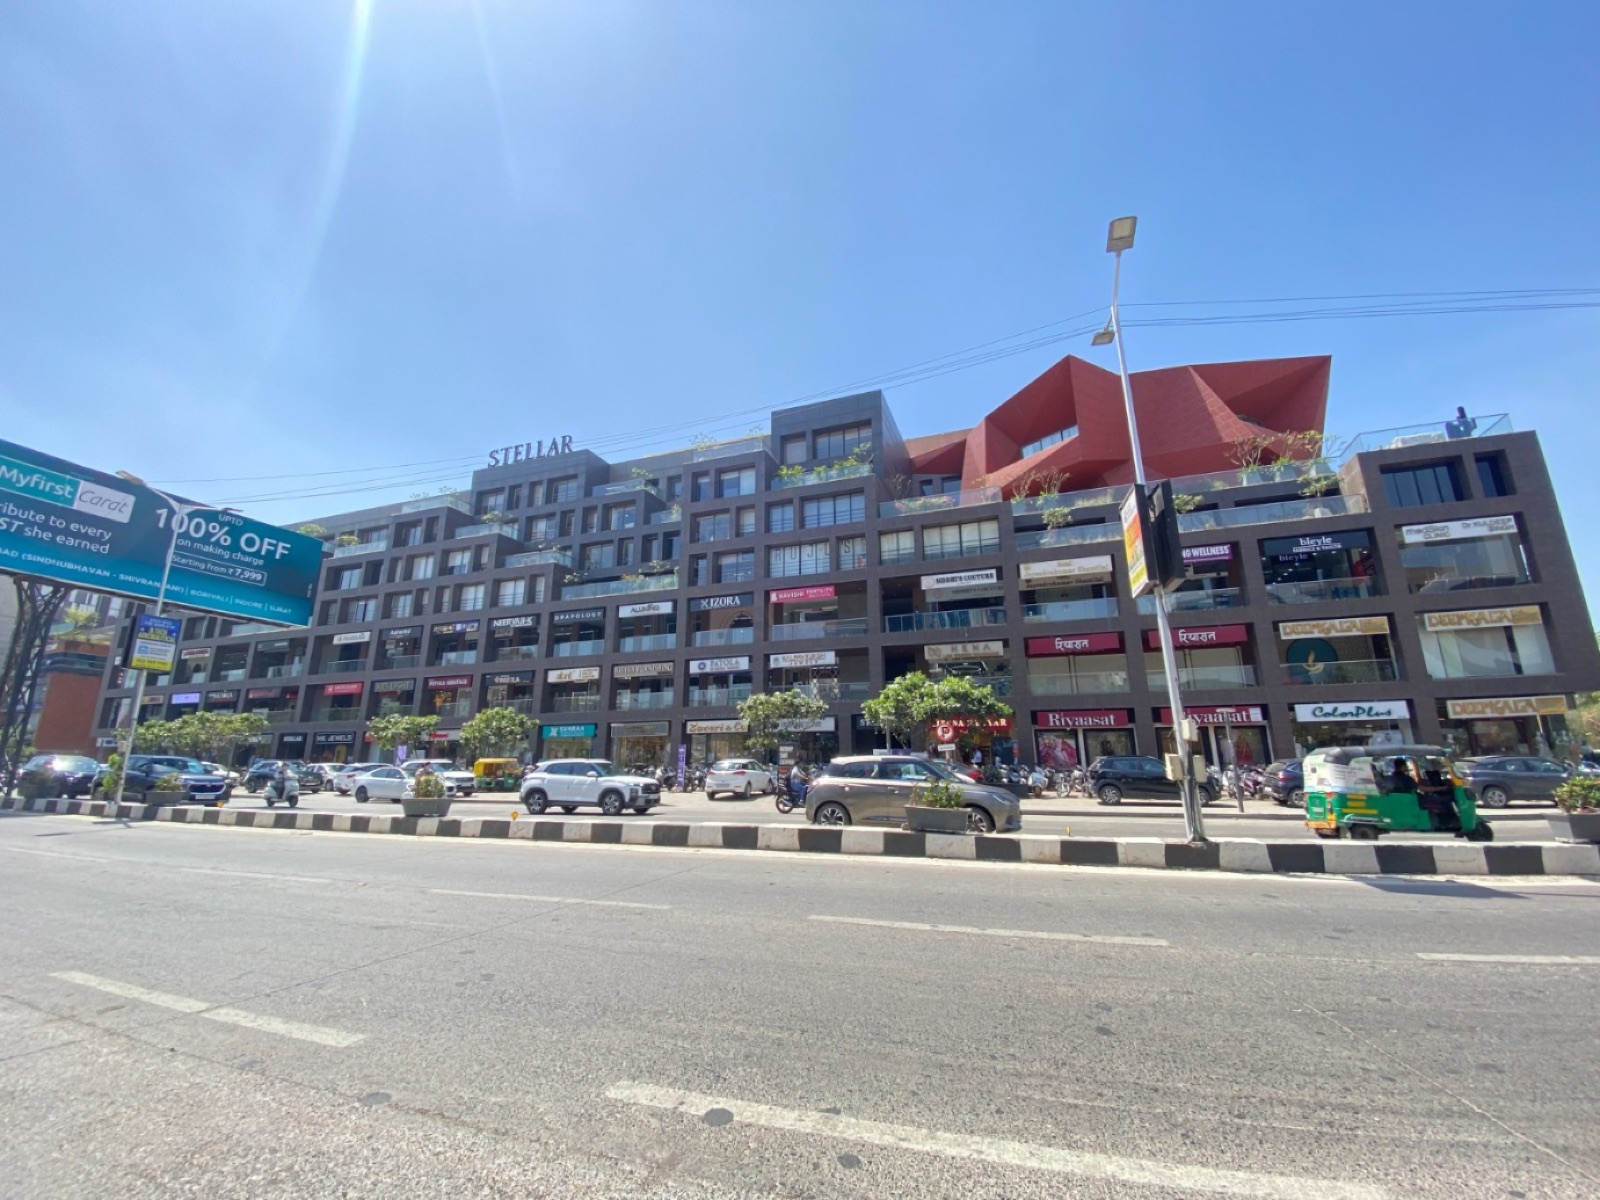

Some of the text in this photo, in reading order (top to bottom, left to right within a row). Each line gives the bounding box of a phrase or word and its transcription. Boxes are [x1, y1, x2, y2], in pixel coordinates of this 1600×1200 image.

[488, 435, 573, 468] STELLAR
[78, 490, 129, 514] Carat
[49, 515, 66, 528] to
[70, 522, 112, 541] every
[218, 514, 244, 526] UPTO
[24, 525, 52, 540] she
[56, 535, 110, 554] earned
[156, 508, 291, 560] 100% OFF
[1300, 537, 1332, 547] bleyle
[177, 538, 264, 566] on making charge
[1192, 544, 1230, 557] WELLNESS
[172, 555, 205, 570] Starting
[207, 559, 227, 573] from
[235, 568, 262, 581] 7,999
[118, 573, 184, 594] SHIVRANANI)
[190, 589, 229, 602] BORIVALI
[234, 598, 264, 609] INDORE
[269, 605, 292, 614] SURAT
[1055, 637, 1089, 651] रियासत
[1179, 630, 1216, 643] रियासत
[1048, 713, 1115, 729] Riyaasat
[1183, 710, 1248, 724] iyaaat
[1312, 706, 1392, 718] ColorPlus
